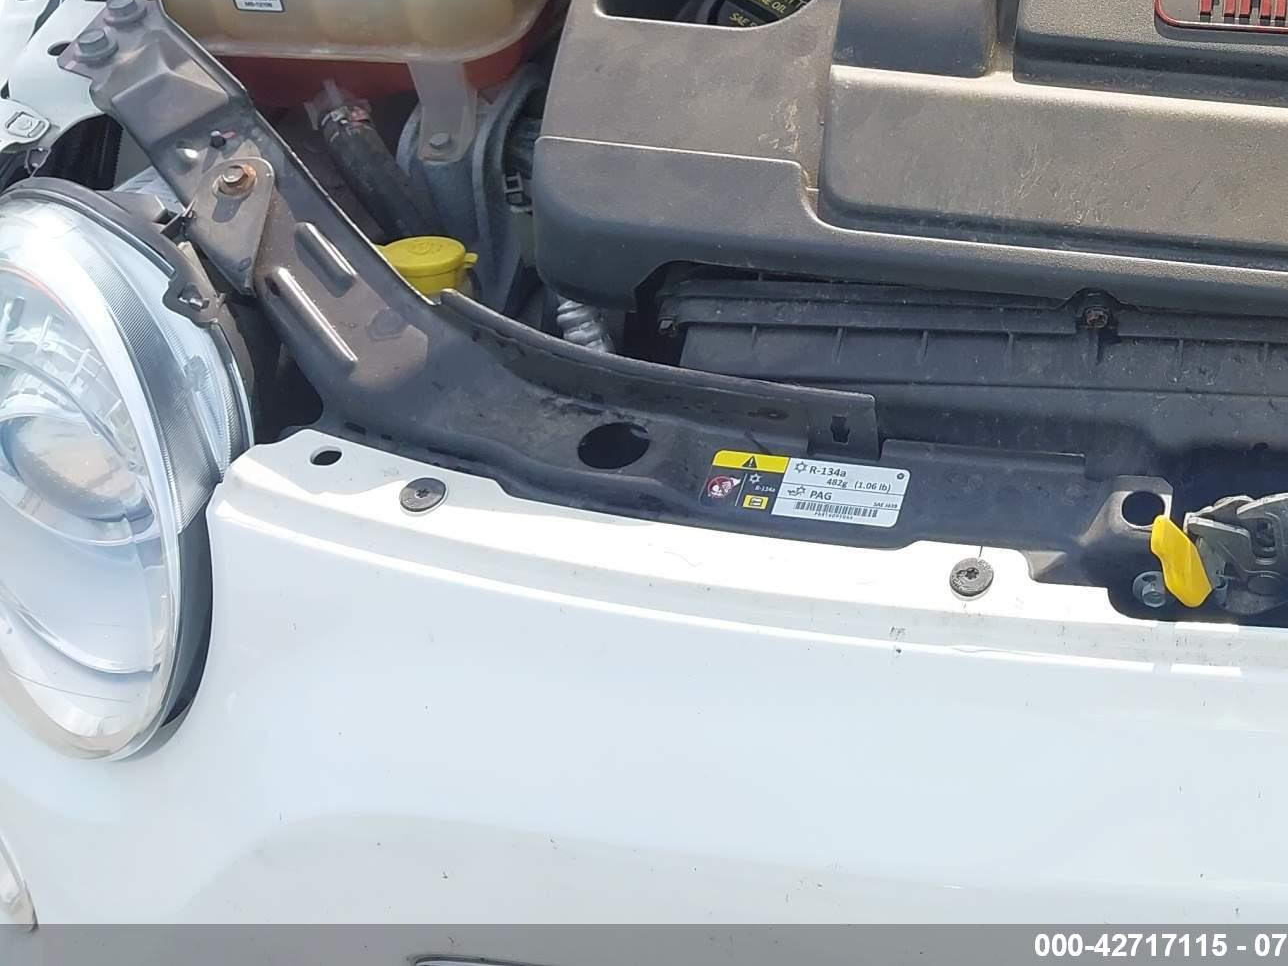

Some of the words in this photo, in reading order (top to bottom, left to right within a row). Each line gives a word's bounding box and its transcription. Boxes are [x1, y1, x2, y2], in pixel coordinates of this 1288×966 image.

[771, 0, 787, 14] OIL
[729, 12, 748, 26] SAE
[809, 465, 847, 478] R-134a
[826, 479, 848, 489] 482g
[854, 480, 877, 491] (1.06
[878, 482, 891, 493] lb)
[809, 490, 833, 501] PAG
